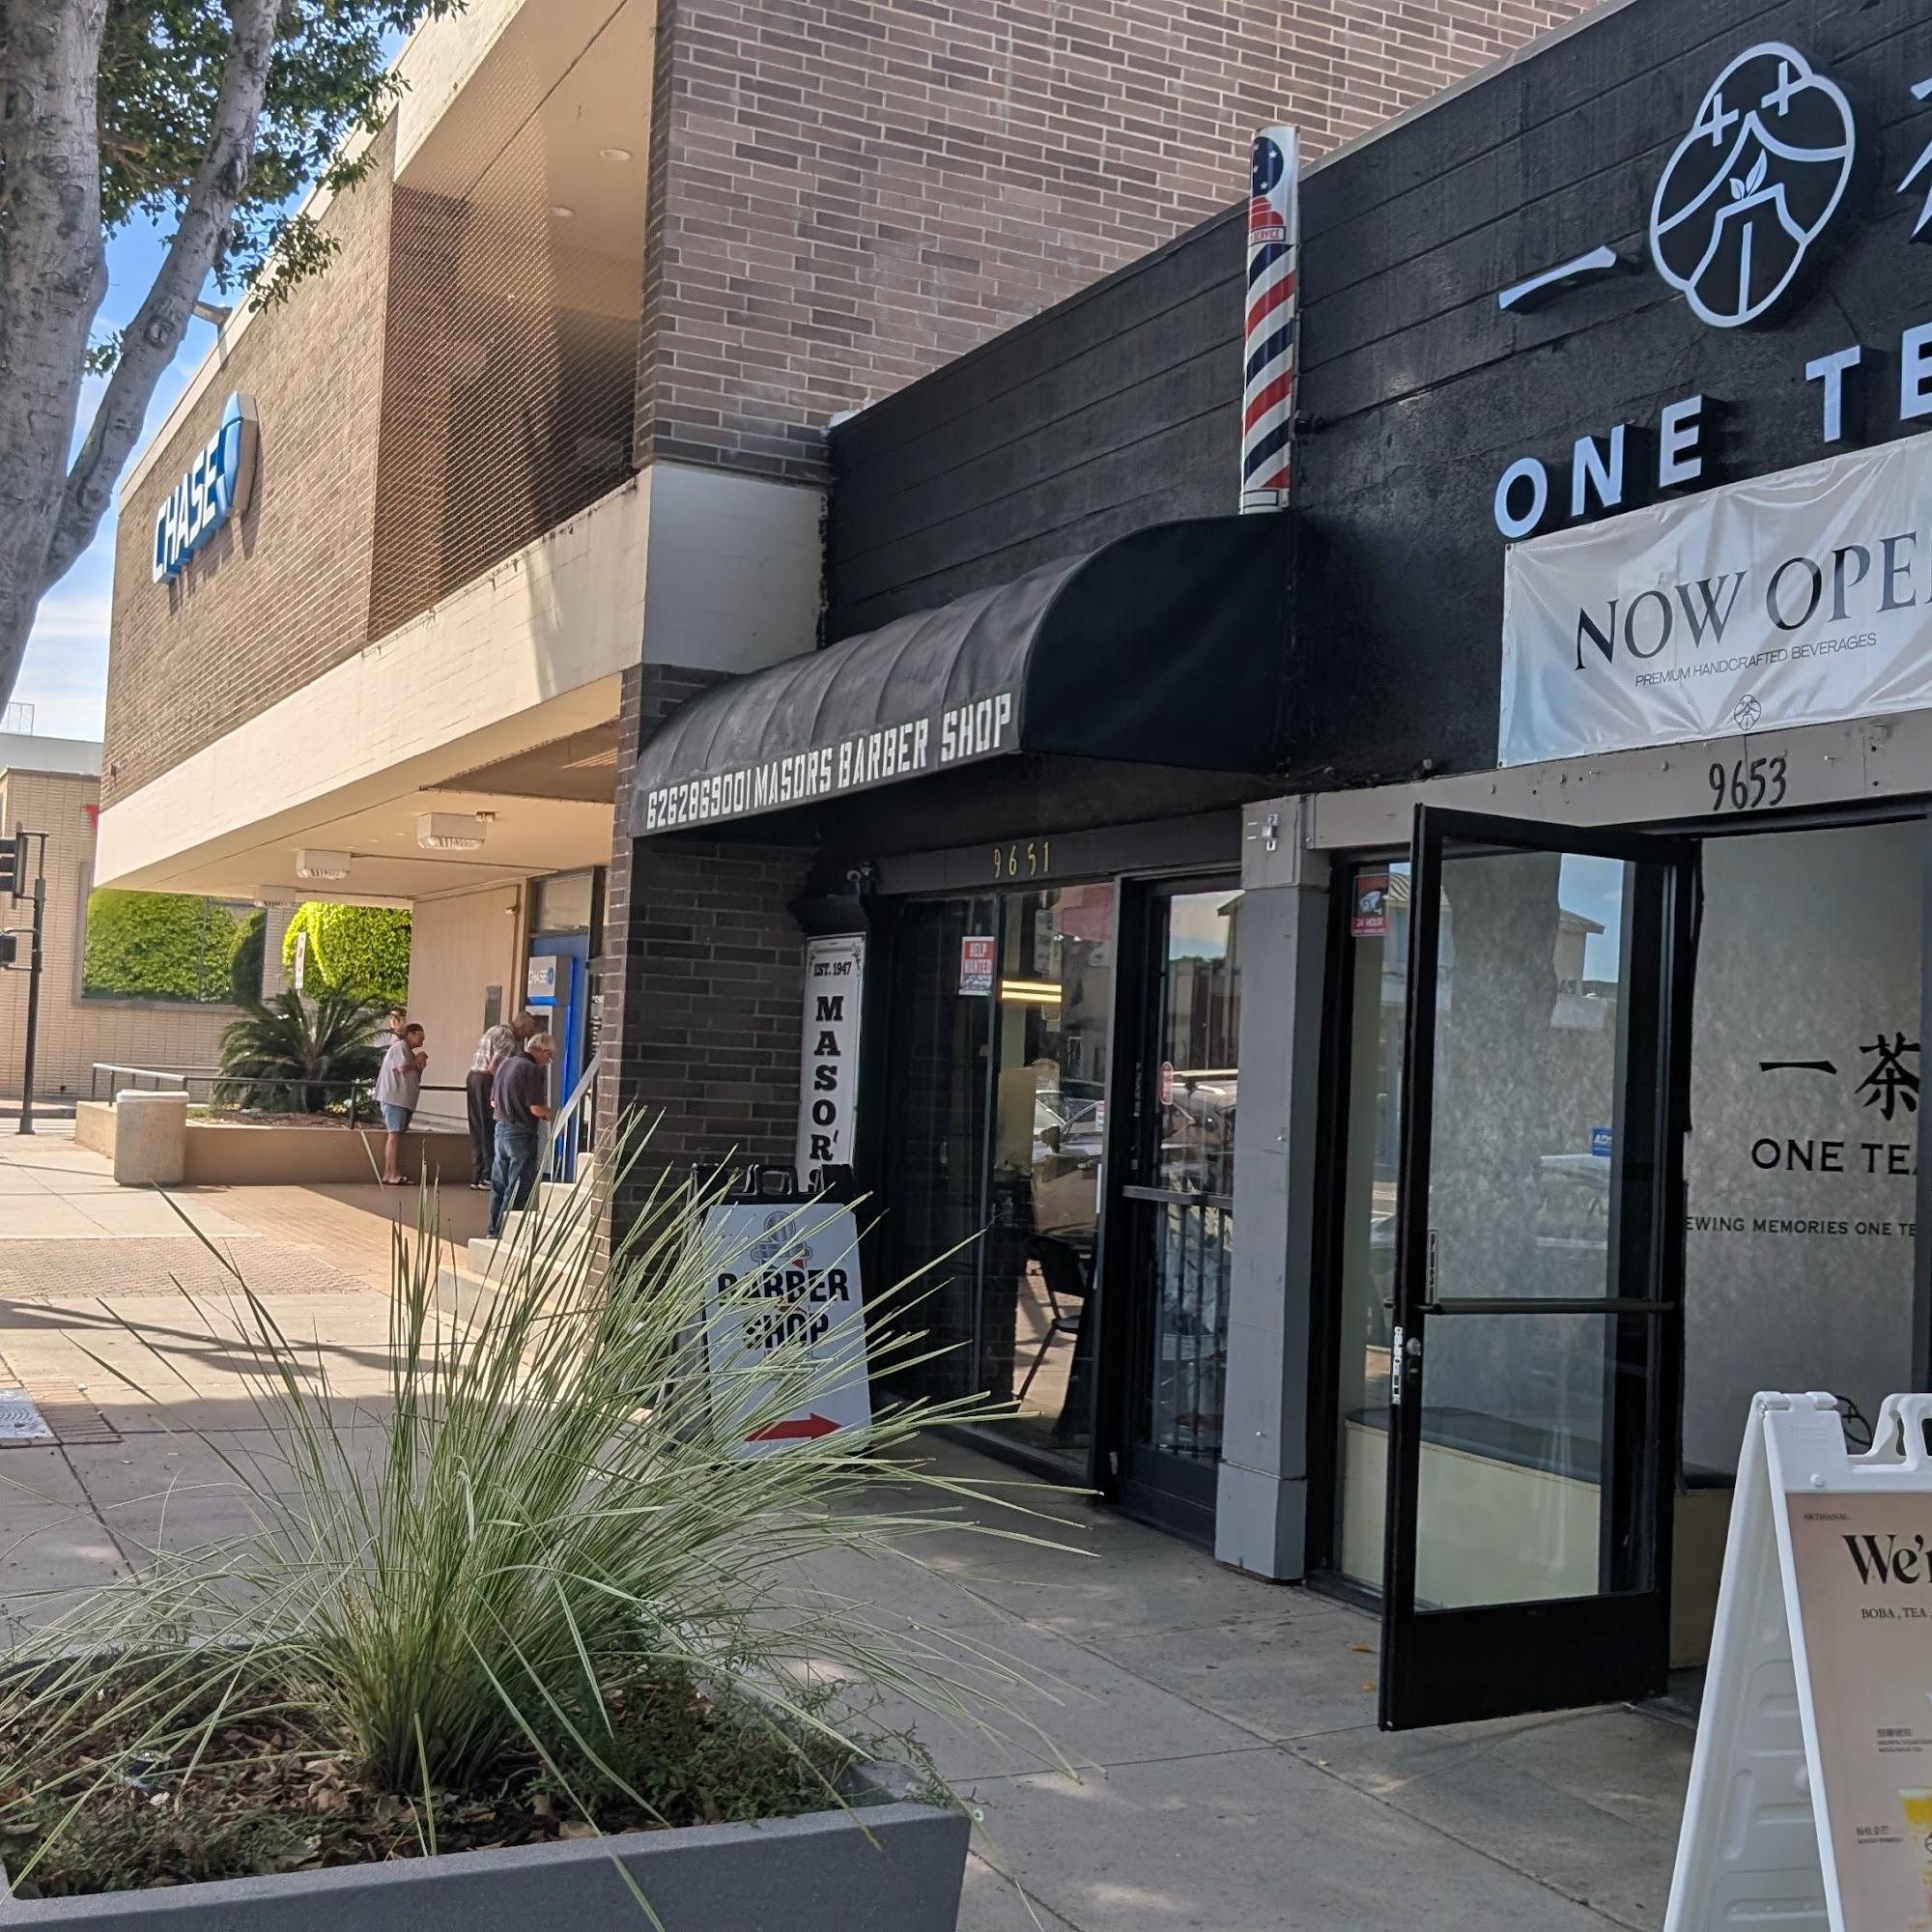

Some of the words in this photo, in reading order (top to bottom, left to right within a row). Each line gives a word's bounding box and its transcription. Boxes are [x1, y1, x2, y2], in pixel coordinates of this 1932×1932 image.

[1494, 394, 1703, 538] ONE
[153, 429, 221, 583] CHASE
[1575, 570, 1747, 670] NOW
[1766, 531, 1932, 631] OPE
[1634, 666, 1691, 688] PREMIUM
[1692, 647, 1788, 677] HANDCRAFTED
[1791, 632, 1877, 660] BEVERAGES
[646, 768, 752, 830] 6262869001
[753, 747, 833, 809] MASORS
[838, 718, 929, 789] BARBER
[940, 692, 1012, 762] SHOP
[1709, 755, 1787, 811] 9653
[994, 841, 1049, 879] 9651
[813, 962, 832, 977] EST.
[833, 961, 852, 976] 1947
[964, 958, 992, 975] WANTED
[969, 942, 987, 958] HELP
[1751, 1138, 1844, 1173] ONE
[1861, 1143, 1918, 1176] TE
[1752, 1218, 1849, 1236] MEMORIES
[1855, 1221, 1892, 1236] ONE
